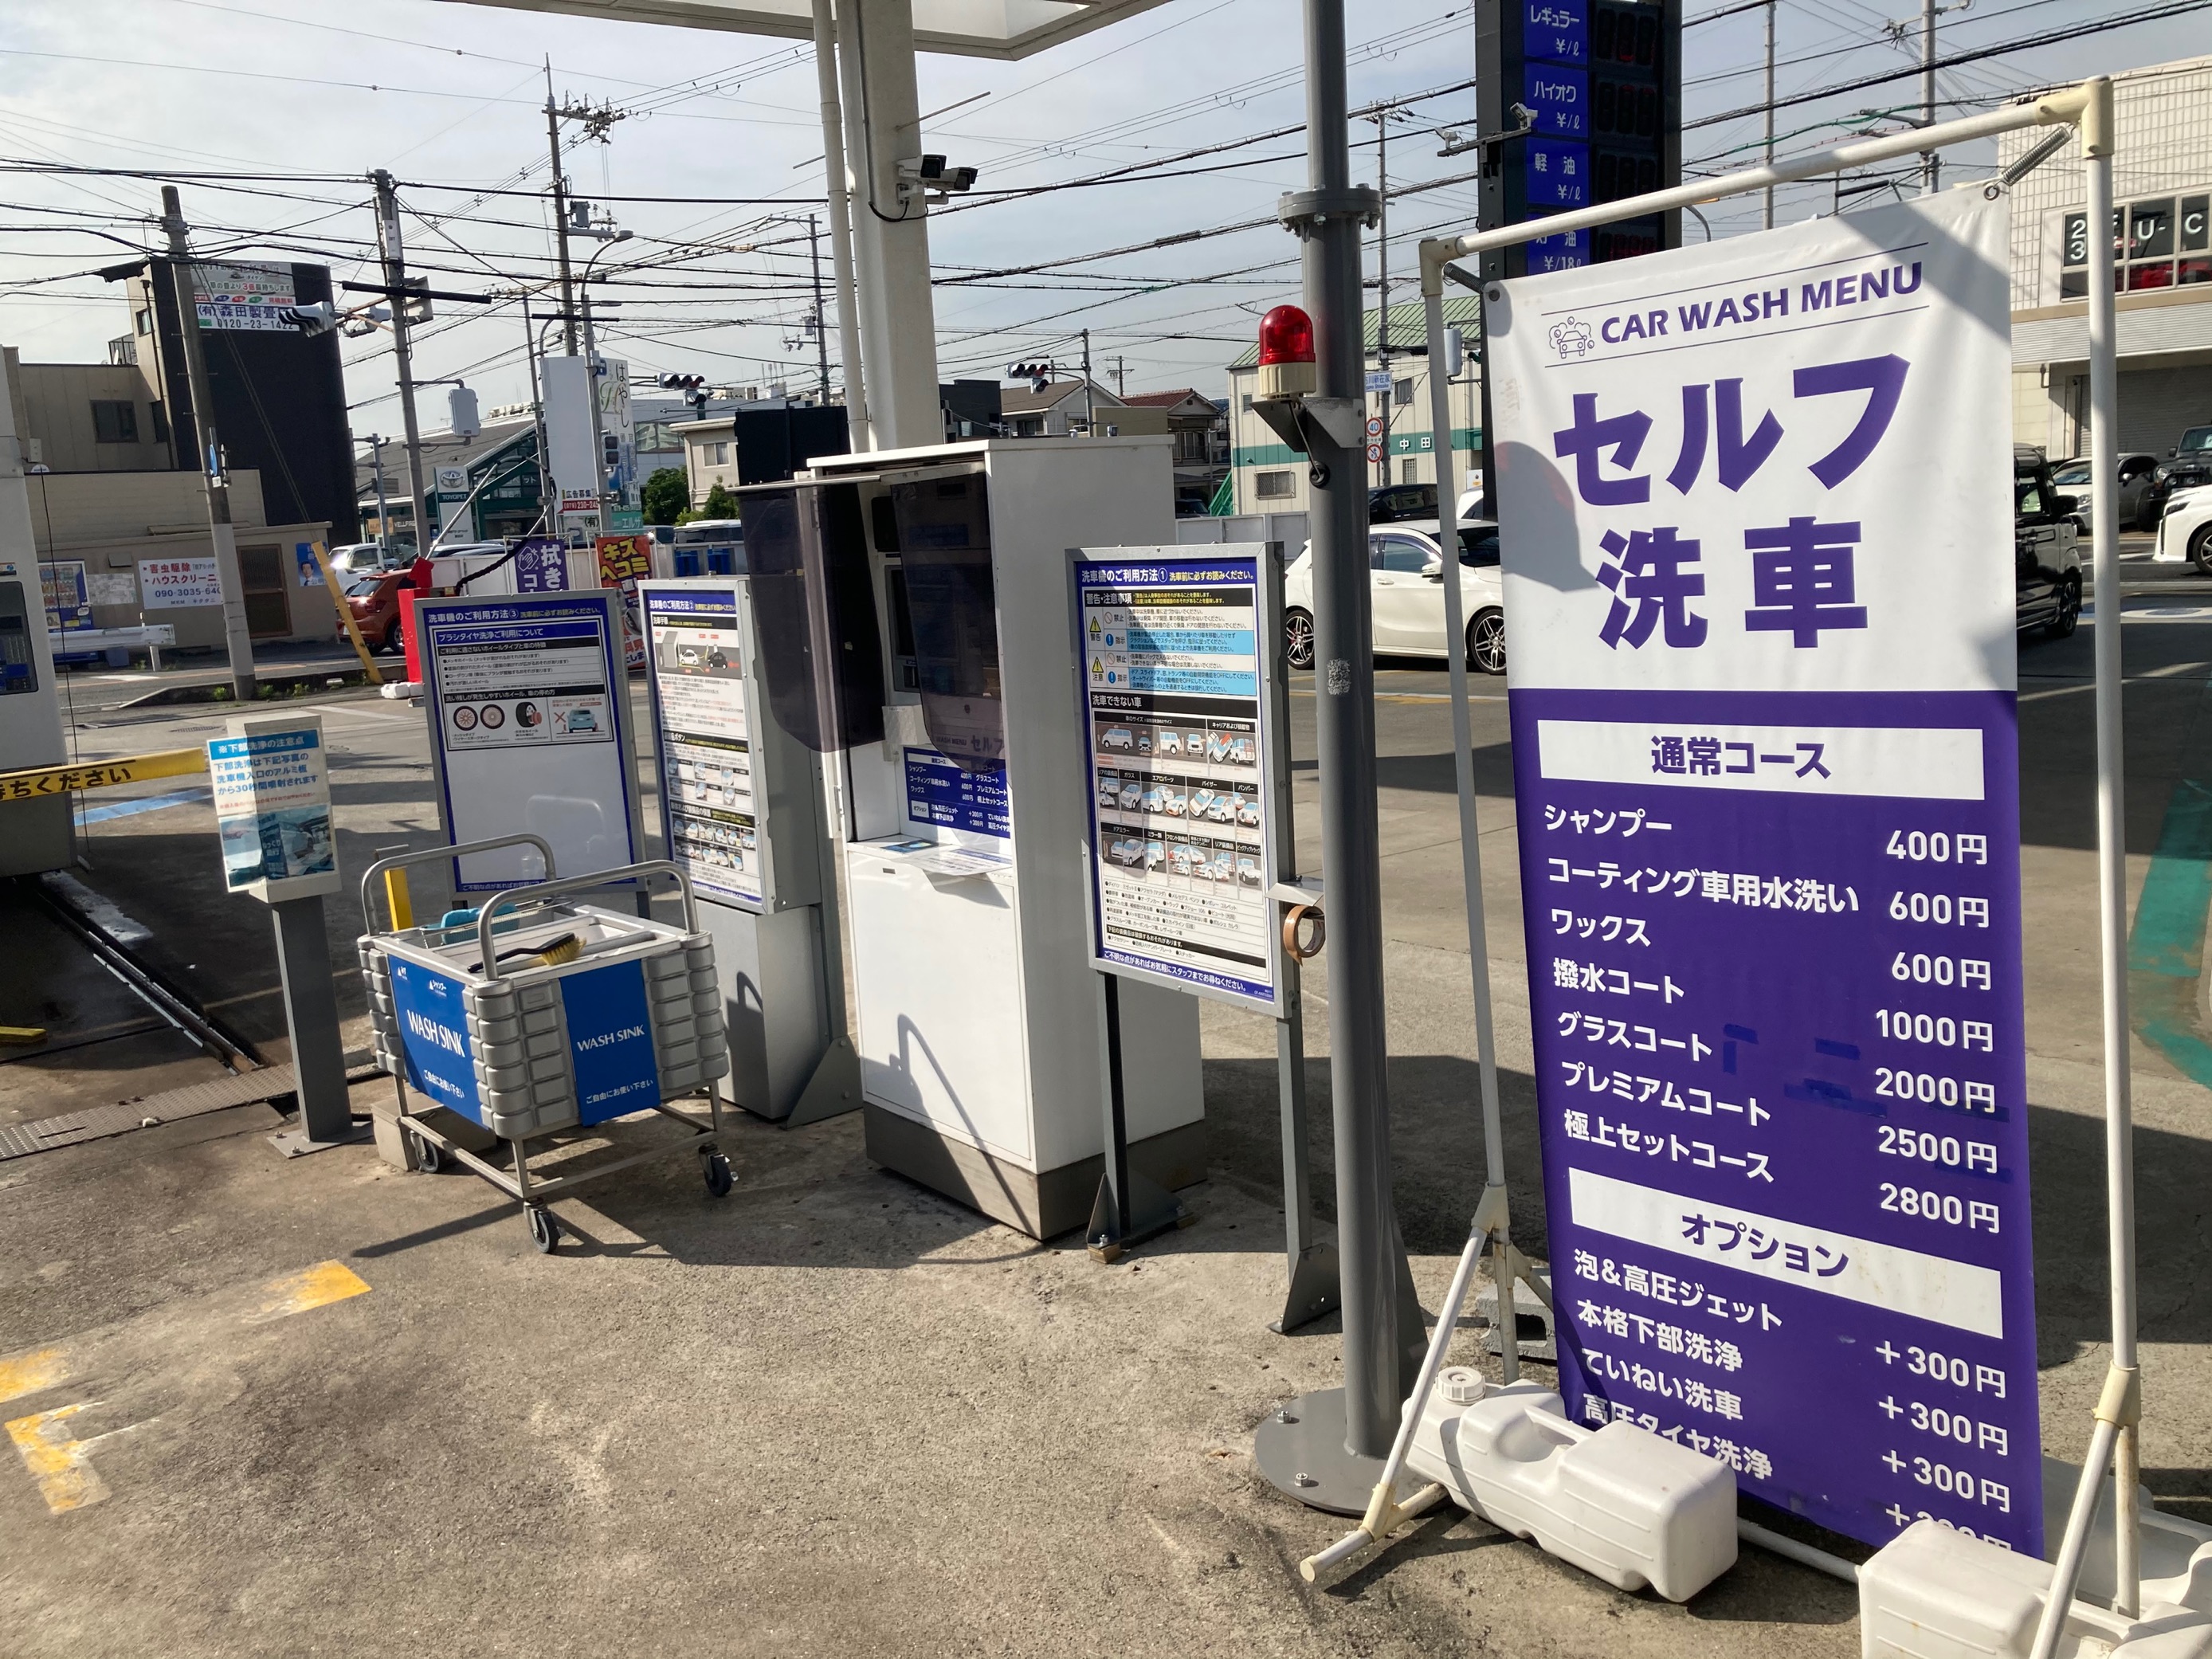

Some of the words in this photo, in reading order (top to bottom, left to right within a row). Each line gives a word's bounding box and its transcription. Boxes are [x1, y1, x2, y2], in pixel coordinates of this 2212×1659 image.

[1530, 5, 1579, 29] レギュラー
[1534, 80, 1577, 103] ハイオク
[198, 304, 281, 319] (有)森田製畳
[1602, 309, 1669, 344] CAR
[1679, 288, 1789, 333] WASH
[1802, 261, 1924, 313] MENU
[615, 363, 629, 428] はやし
[1400, 437, 1431, 450] 中田
[1553, 353, 1911, 506] セルフ
[566, 489, 592, 499] 広告募集
[602, 537, 638, 561] キズ
[150, 563, 191, 575] 害虫駆除
[151, 574, 218, 586] ハウスクリーニ
[540, 544, 562, 589] 拭き
[601, 556, 649, 580] ヘコミ
[1169, 570, 1254, 581] 洗車前に必ずお読みください。
[524, 574, 538, 592] コ
[1595, 516, 1869, 650] 洗車
[520, 606, 602, 619] 洗車前に必ずお読みください。
[438, 628, 544, 642] ブラシタイヤ洗浄ご利用について
[1116, 636, 1126, 645] 指示
[1116, 655, 1128, 664] 禁止
[1092, 673, 1104, 682] 注意
[1092, 694, 1142, 708] 洗車できない車
[971, 735, 1004, 755] セルフ
[1651, 735, 1832, 780] 通常コース
[214, 752, 309, 771] 下部洗浄は下記写真の
[217, 764, 308, 784] 洗車機入口のアルミ板
[218, 775, 318, 795] から30秒間噴射されます
[910, 785, 925, 794] ワックス
[975, 774, 999, 784] グラスコート
[976, 785, 1007, 796] プレミアムコート
[1544, 804, 1673, 838] シャンプー
[1886, 830, 1988, 865] 400円
[1548, 857, 1859, 914] コーティング車用水洗い
[1889, 892, 1990, 928] 600円
[1551, 909, 1651, 947] ワックス
[1104, 950, 1246, 992] ご不明な点があればお気軽にスタッフまでお尋ねください。
[1553, 958, 1684, 1005] 撥水コート
[1891, 952, 1991, 990] 600円
[407, 1009, 439, 1045] WASH
[439, 1024, 465, 1058] SINK
[577, 1033, 615, 1052] WASH
[617, 1024, 645, 1041] SINK
[1557, 1011, 1712, 1062] グラスコート
[1876, 1009, 1994, 1053] 1000円
[424, 1069, 465, 1099] ご自由にお使い下さい
[586, 1079, 653, 1104] ご自由にお使い下さい
[1561, 1061, 1771, 1126] プレミアムコート
[1875, 1068, 1995, 1114] 2000円
[1563, 1109, 1775, 1184] 極上セットコース
[1878, 1125, 1998, 1174] 2500円
[1880, 1182, 2000, 1234] 2800円
[1681, 1213, 1849, 1277] オプション
[1575, 1249, 1783, 1332] 泡&高圧ジェット
[1578, 1299, 1743, 1372] 本格下部洗浄
[1582, 1348, 1743, 1422] ていねい洗車
[1583, 1393, 1773, 1481] 高圧タイヤ洗浄
